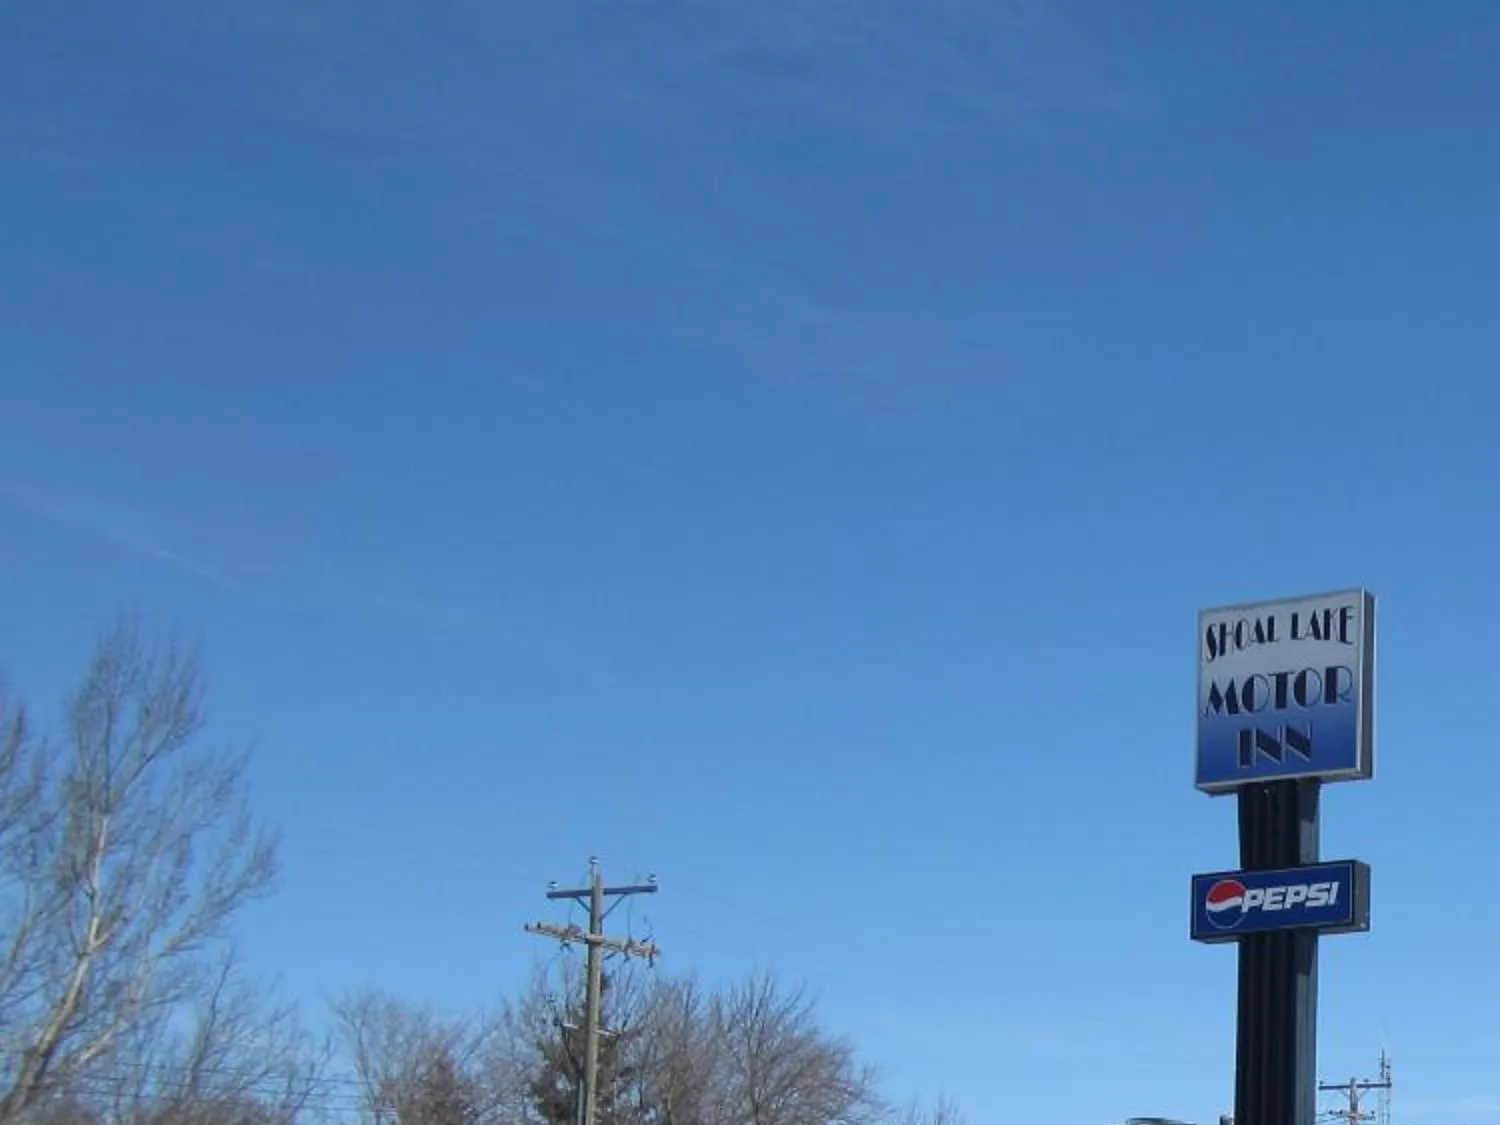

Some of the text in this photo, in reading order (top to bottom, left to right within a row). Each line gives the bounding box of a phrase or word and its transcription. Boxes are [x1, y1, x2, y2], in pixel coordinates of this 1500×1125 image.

[1206, 605, 1355, 663] SHOAL LAKE
[1204, 666, 1353, 717] MOTOR
[1237, 720, 1313, 768] INN
[1241, 881, 1340, 912] PEPSI
